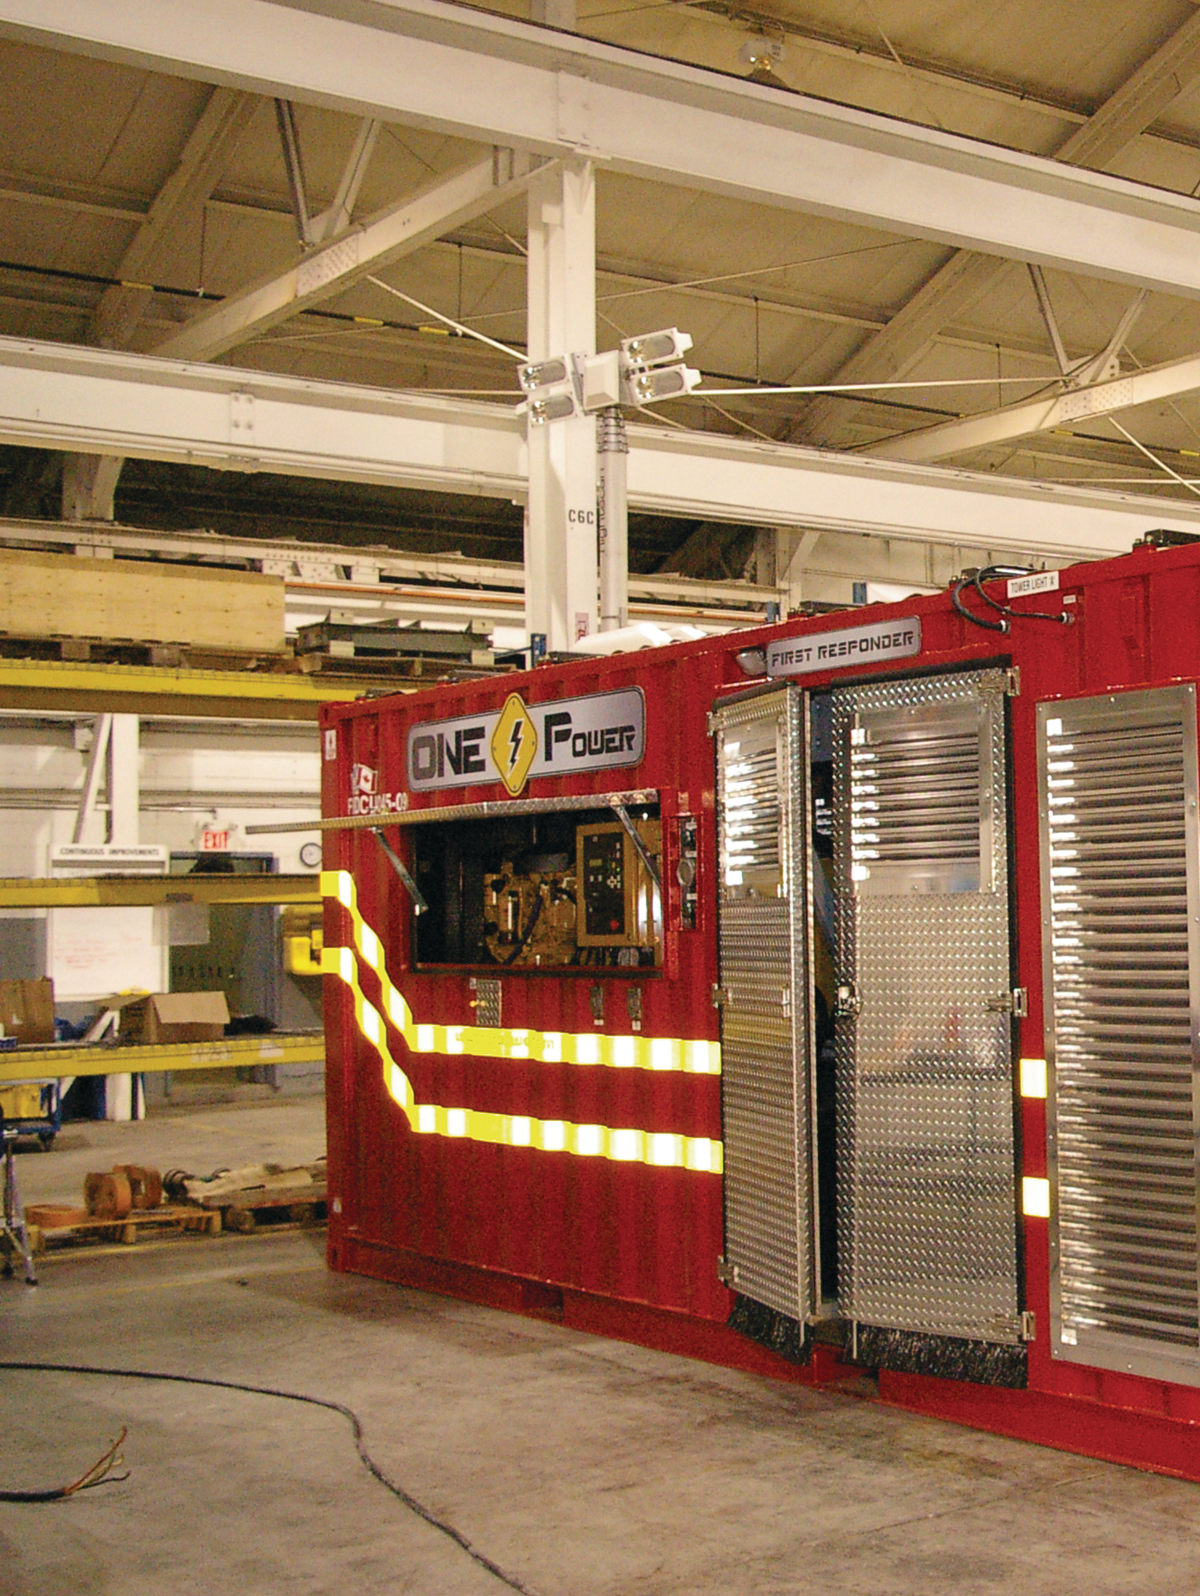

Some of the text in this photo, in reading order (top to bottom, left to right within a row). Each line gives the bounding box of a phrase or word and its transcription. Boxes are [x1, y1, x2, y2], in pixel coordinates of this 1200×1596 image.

[568, 508, 595, 525] C6C
[1011, 580, 1031, 594] TOWER
[1031, 576, 1048, 590] LIGHT
[772, 631, 914, 667] FIRST RESPONDER
[412, 711, 637, 781] ONE POWER
[204, 831, 229, 849] EXIT
[60, 847, 160, 856] CONTINUOUS IMPROVEMENTS
